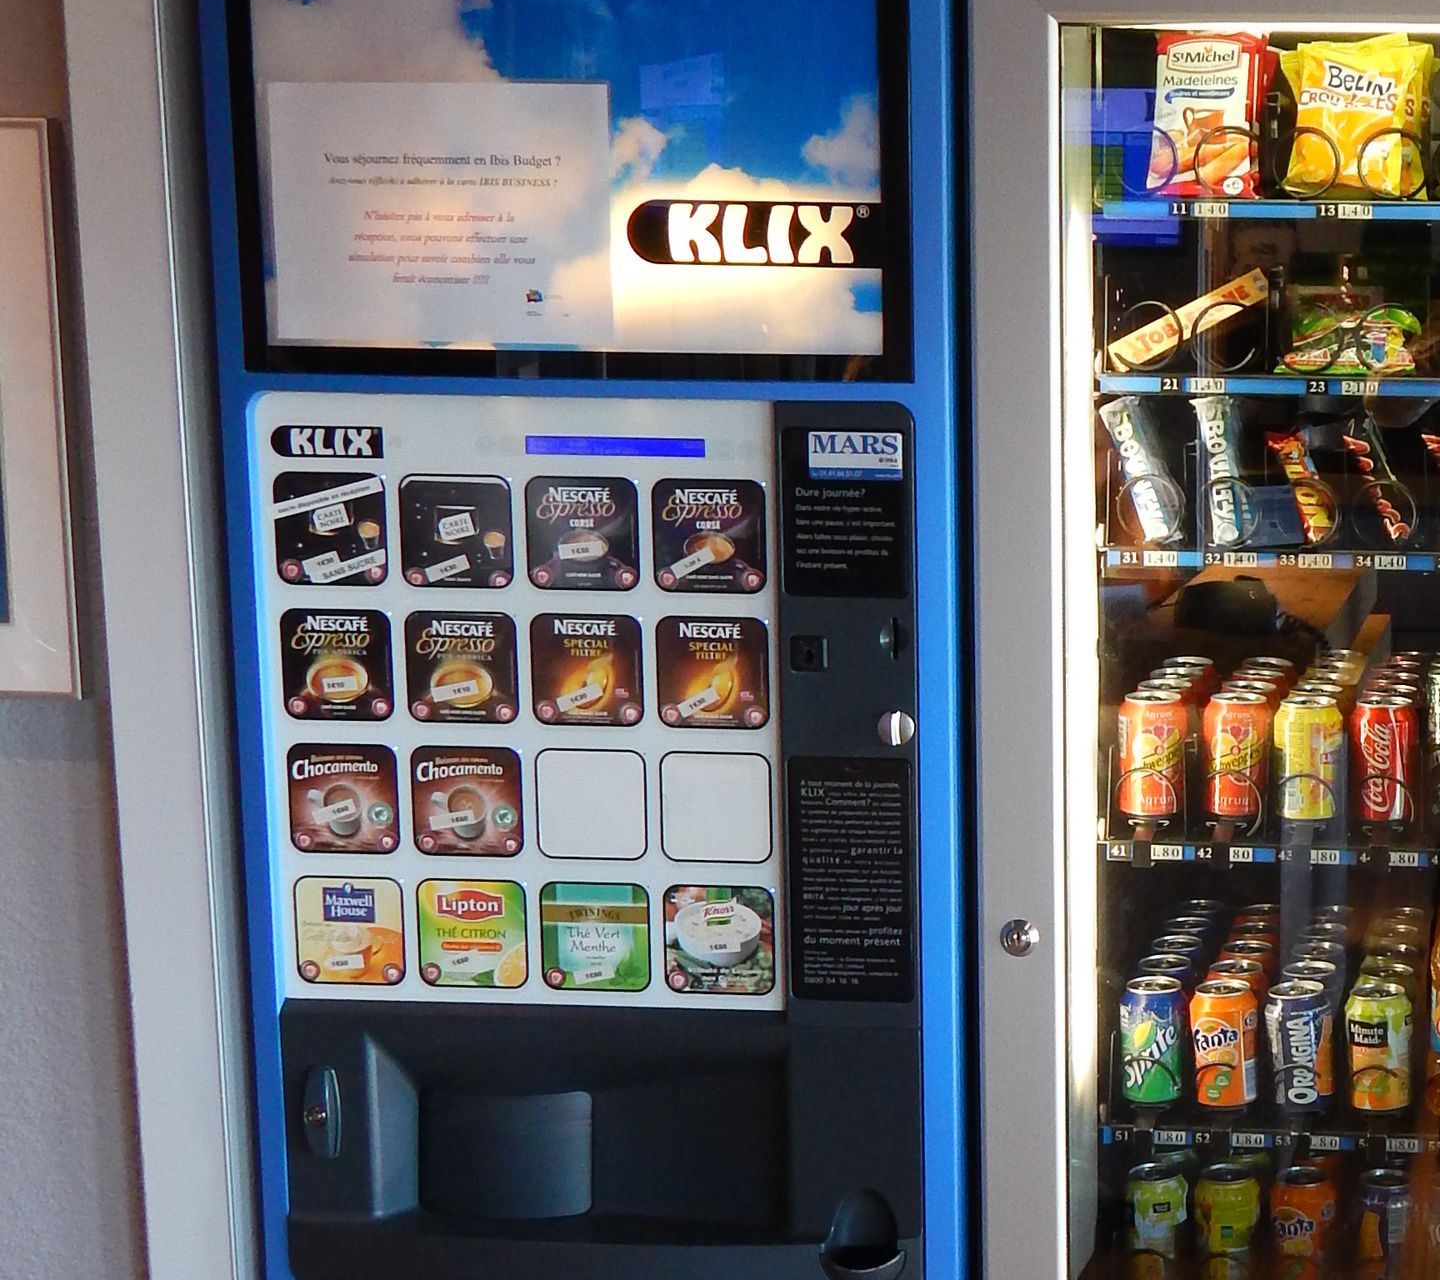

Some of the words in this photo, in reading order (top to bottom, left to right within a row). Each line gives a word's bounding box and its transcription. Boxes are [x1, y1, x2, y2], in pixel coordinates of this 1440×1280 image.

[1162, 74, 1239, 88] Madeleines
[324, 152, 349, 164] Vous
[473, 156, 487, 165] en
[490, 154, 510, 166] Ibis
[513, 154, 552, 169] Budget
[502, 178, 551, 188] BUSINESS
[1171, 203, 1188, 215] 11
[1319, 204, 1336, 217] 13
[667, 202, 855, 264] KLIX
[1162, 377, 1179, 391] 21
[1309, 380, 1327, 393] 23
[289, 427, 373, 456] KLIX
[811, 434, 899, 456] MARS
[548, 486, 612, 504] NESCAFÉ
[675, 488, 739, 506] NESCAFÉ
[535, 490, 617, 526] Espresso
[661, 493, 744, 528] Espresso
[1121, 552, 1138, 565] 31
[1205, 552, 1222, 565] 32
[1279, 554, 1296, 566] 33
[1355, 555, 1372, 567] 34
[321, 566, 347, 580] SANS
[305, 615, 369, 632] NESCAFÉ
[431, 619, 495, 638] NESCAFÉ
[553, 619, 618, 636] NESCAFÉ
[679, 622, 743, 640] NESCAFÉ
[290, 623, 371, 656] Espresso
[415, 627, 497, 661] Espresso
[291, 759, 379, 781] Chocamento
[416, 761, 504, 783] Chocamento
[800, 786, 826, 797] KLIX
[1110, 844, 1127, 855] 41
[1197, 847, 1213, 859] 42
[325, 892, 373, 908] Maxwell
[441, 896, 499, 915] Lipton
[330, 904, 368, 918] House
[435, 925, 458, 938] THÉ
[460, 927, 507, 940] CITRON
[565, 926, 592, 940] Thé
[594, 927, 621, 940] Vert
[570, 939, 617, 954] Menthe
[819, 936, 861, 945] moment
[1350, 1022, 1385, 1036] Minute
[1123, 1024, 1178, 1089] Sprite
[1114, 1130, 1129, 1141] 51
[1194, 1133, 1211, 1144] 52
[1274, 1135, 1291, 1146] 53
